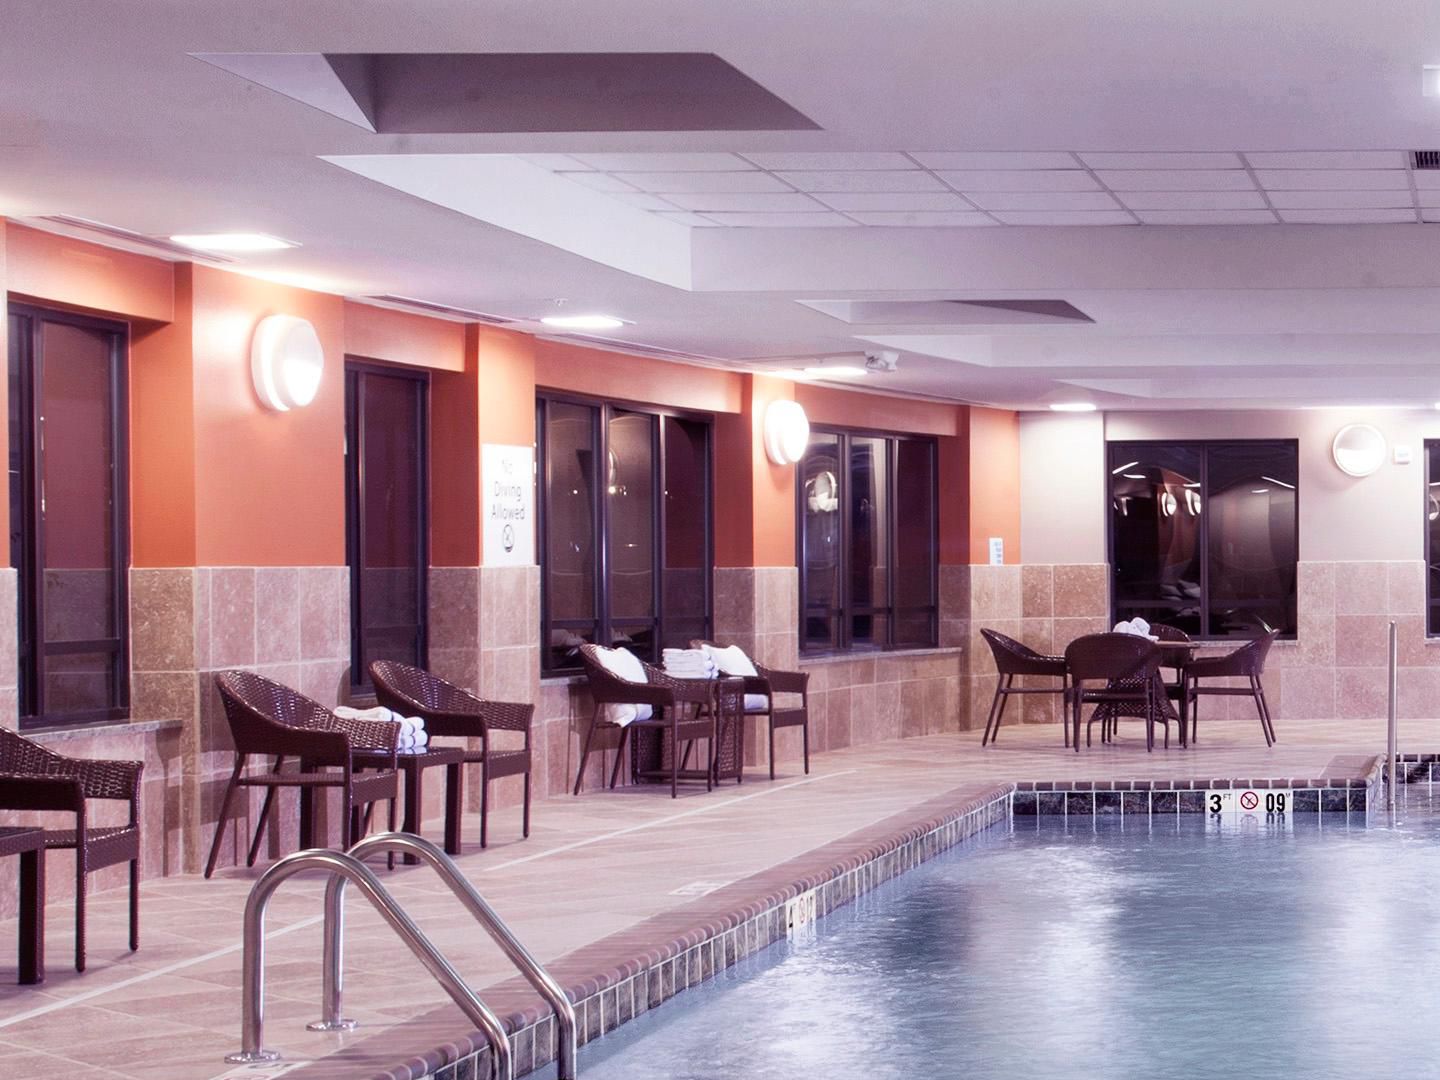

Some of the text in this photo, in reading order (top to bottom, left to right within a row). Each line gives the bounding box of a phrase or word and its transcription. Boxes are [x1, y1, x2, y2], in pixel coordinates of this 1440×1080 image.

[494, 481, 522, 501] Diving
[491, 503, 525, 520] Allowed
[1209, 794, 1222, 813] 3
